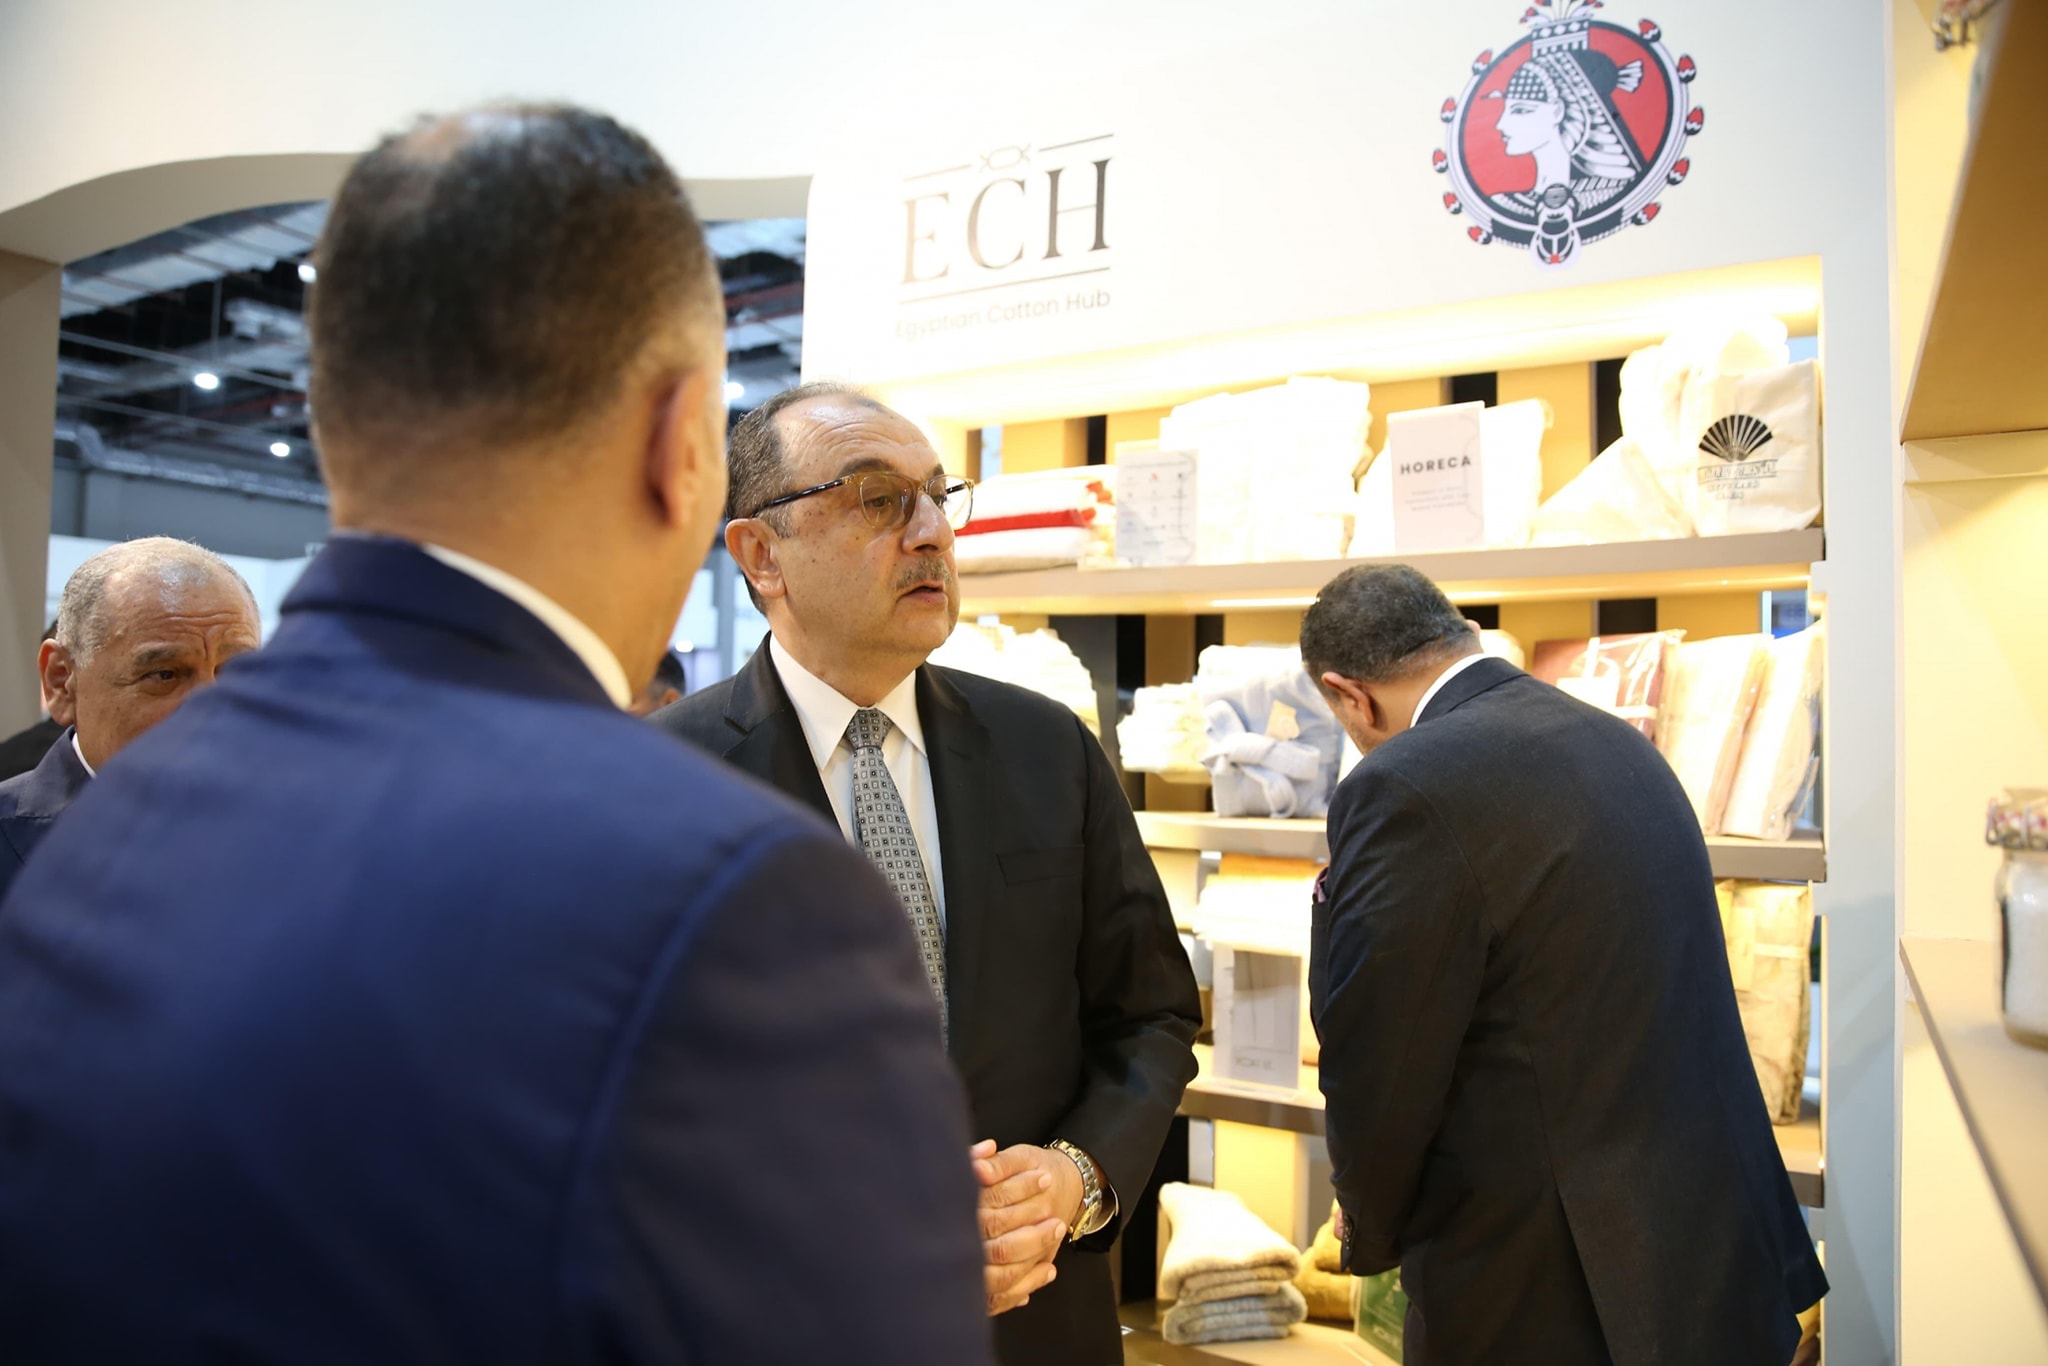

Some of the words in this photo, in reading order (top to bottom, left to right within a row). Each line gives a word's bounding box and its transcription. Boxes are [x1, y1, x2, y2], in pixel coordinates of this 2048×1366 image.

[901, 157, 1113, 285] ECH
[895, 309, 981, 342] Egyptian
[987, 299, 1060, 324] Cotton
[1066, 288, 1112, 311] Hub
[1400, 455, 1472, 475] HORECA
